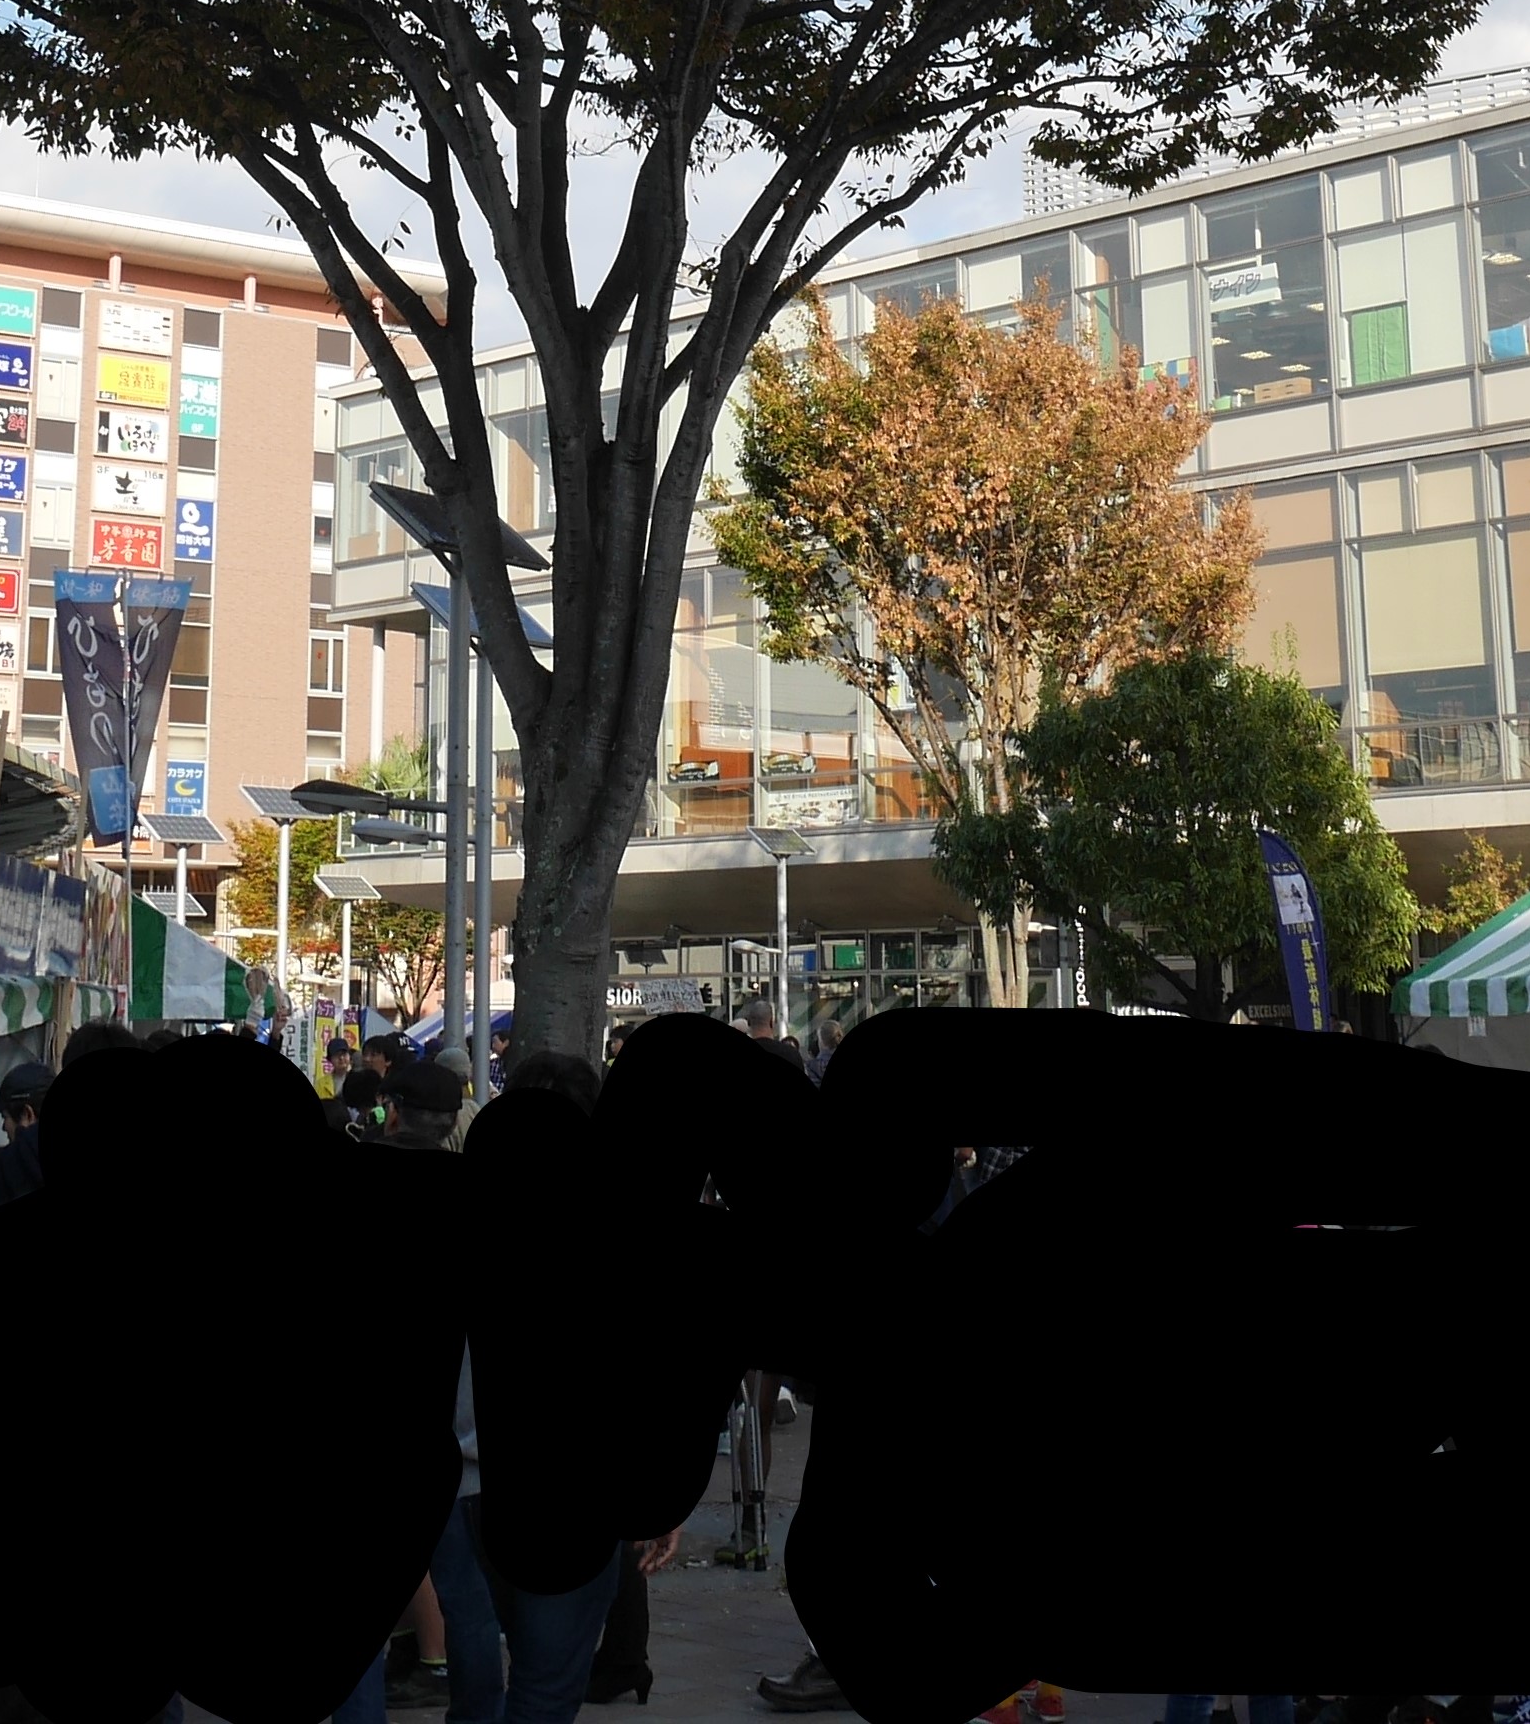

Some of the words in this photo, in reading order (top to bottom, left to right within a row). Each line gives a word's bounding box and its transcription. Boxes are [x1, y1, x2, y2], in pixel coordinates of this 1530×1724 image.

[181, 378, 218, 406] 東進
[180, 404, 217, 418] ハイスクール
[97, 465, 110, 474] 3F
[176, 534, 210, 547] 四谷大塚
[167, 767, 203, 779] カラオケ
[605, 986, 643, 1006] SIOR
[1248, 1004, 1292, 1019] EXCELSIOR
[286, 1024, 296, 1059] コーヒ
